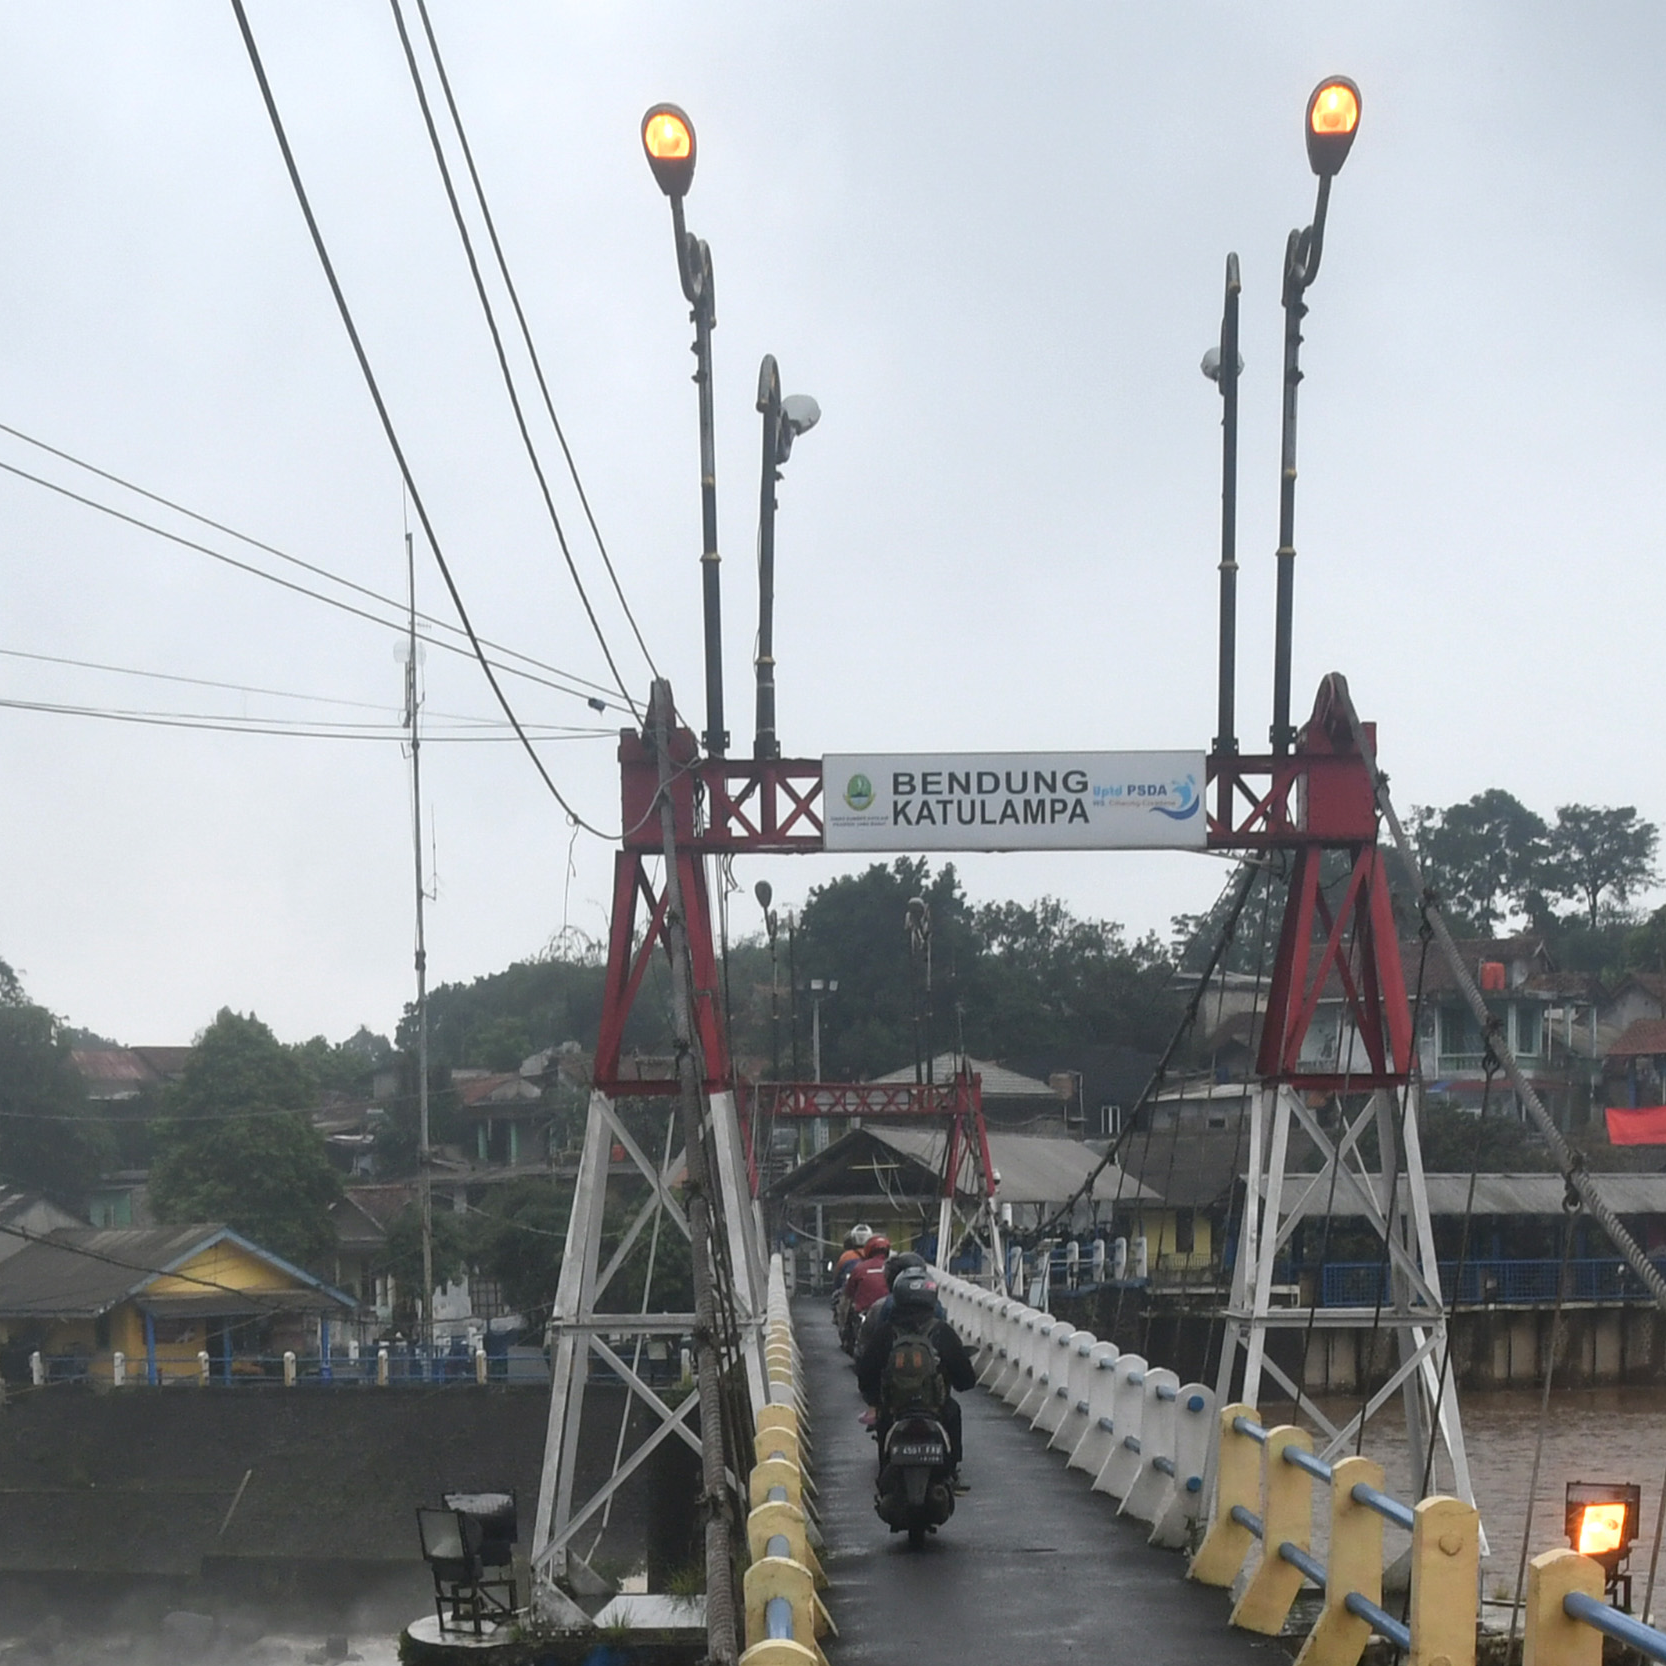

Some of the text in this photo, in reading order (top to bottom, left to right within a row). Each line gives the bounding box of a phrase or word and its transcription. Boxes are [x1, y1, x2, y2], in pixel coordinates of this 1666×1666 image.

[892, 770, 1090, 796] BENDUNG
[1127, 784, 1168, 796] PSDA
[892, 797, 1090, 827] KATULAMPA
